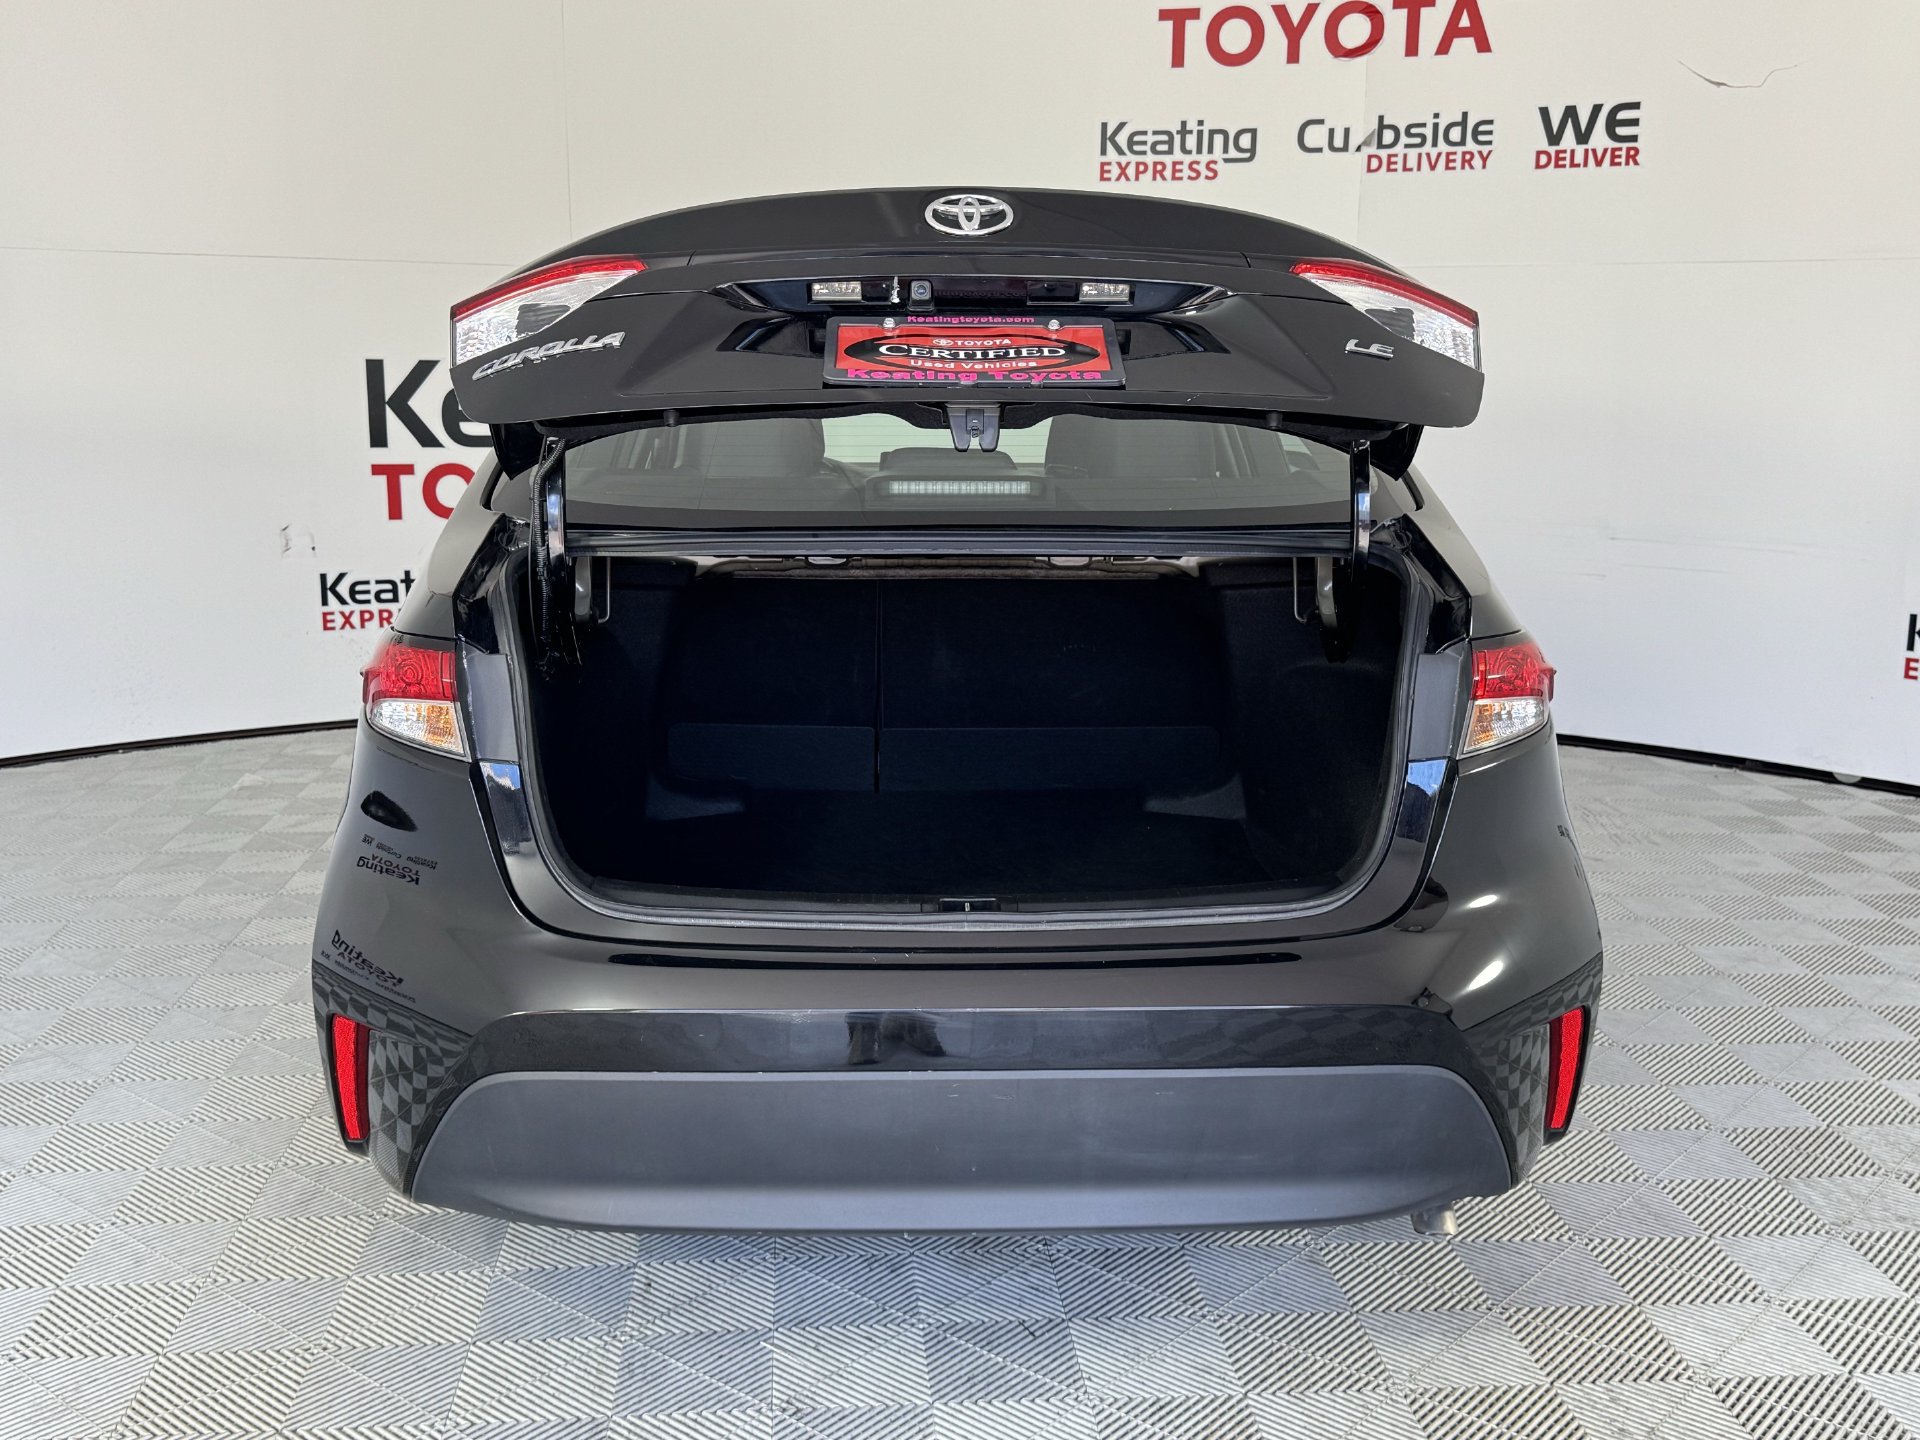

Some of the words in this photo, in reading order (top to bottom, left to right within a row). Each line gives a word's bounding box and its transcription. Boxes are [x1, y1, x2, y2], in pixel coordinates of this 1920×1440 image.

[1158, 0, 1493, 68] TOYOTA
[1296, 111, 1494, 154] Cubside
[1537, 101, 1642, 147] WE
[1100, 119, 1259, 164] Keating
[1366, 150, 1493, 174] DELIVERY
[1533, 146, 1641, 170] DELIVER
[1099, 159, 1219, 182] EXPRESS
[907, 315, 1035, 324] Keatingtoyota.com
[878, 344, 1066, 359] CERTIFIED
[954, 338, 1012, 347] TOYOTA
[1345, 338, 1395, 359] LE
[472, 331, 626, 381] COROLLA
[910, 360, 956, 369] Used
[847, 368, 978, 381] Keating
[988, 370, 1101, 382] Toyota
[371, 463, 475, 520] TO
[321, 609, 394, 631] EXPR
